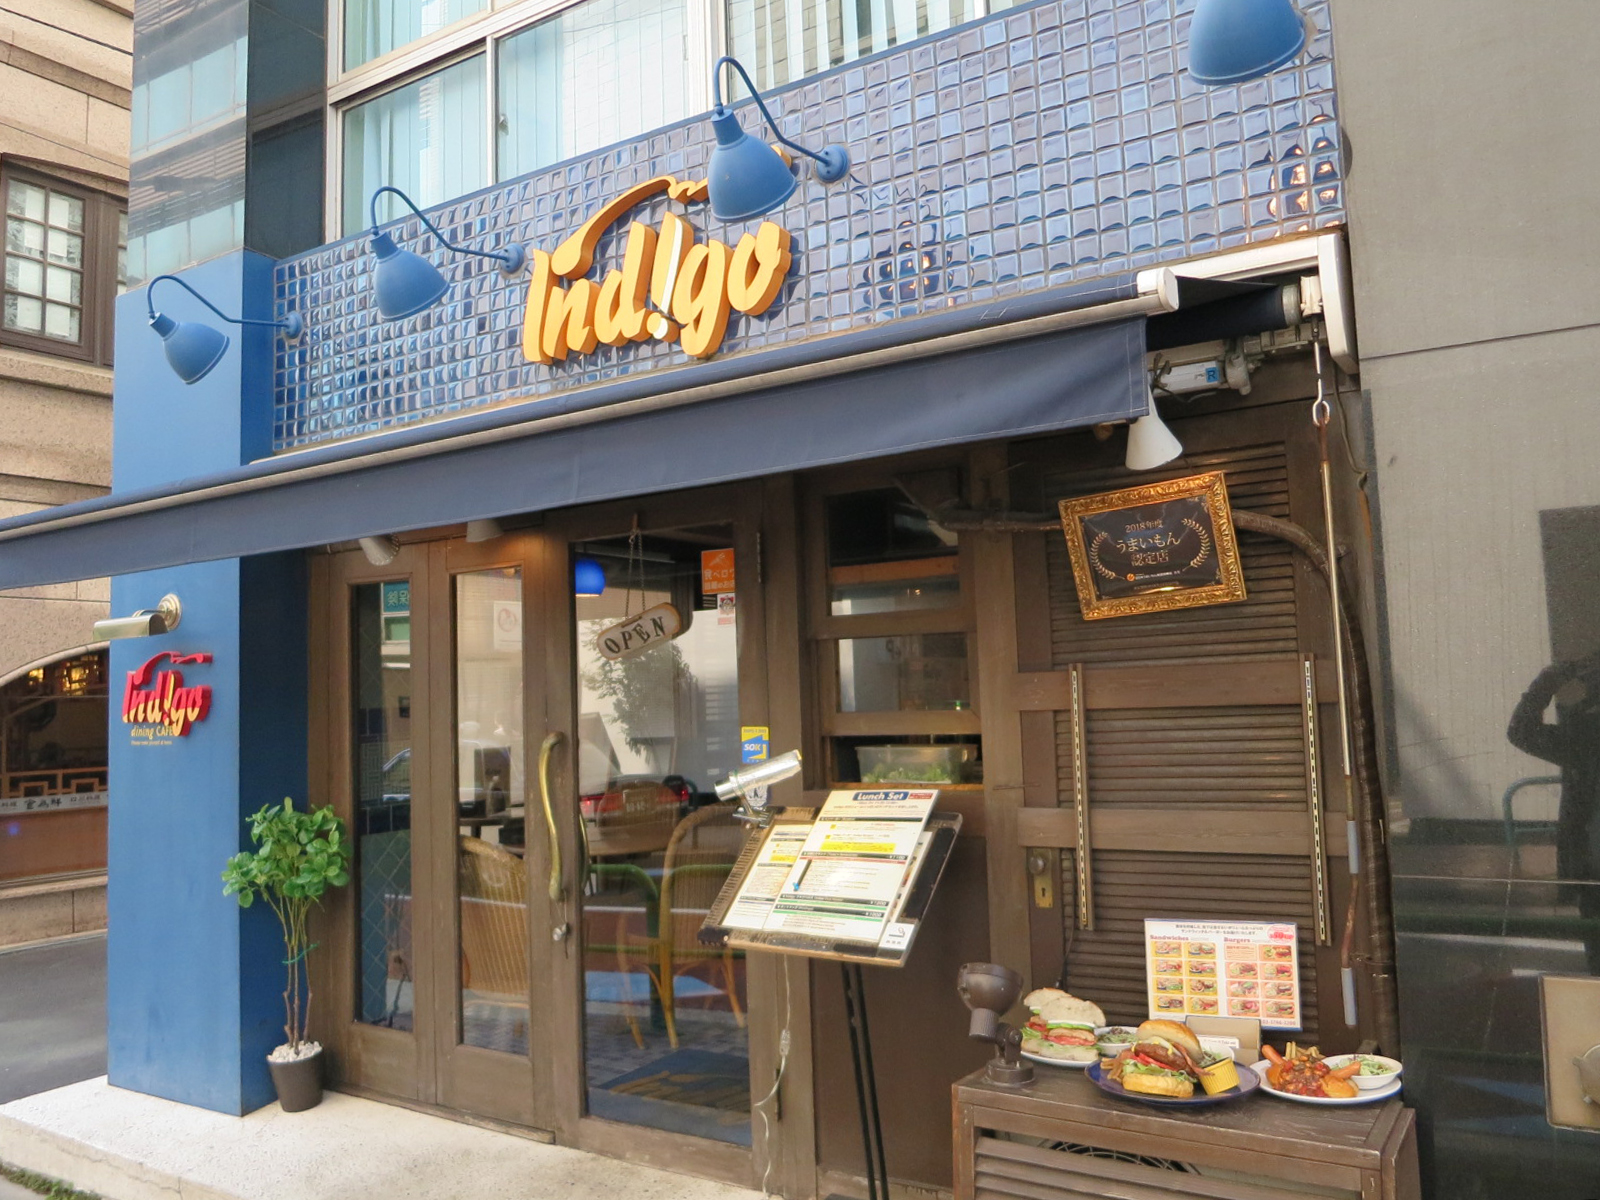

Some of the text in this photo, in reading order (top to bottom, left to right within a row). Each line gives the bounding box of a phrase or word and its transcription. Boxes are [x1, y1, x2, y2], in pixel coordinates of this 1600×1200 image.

[1207, 369, 1216, 381] R
[1125, 520, 1164, 533] 2018年度
[1116, 532, 1181, 554] うまいもん
[1131, 550, 1169, 567] 認定店
[604, 616, 666, 655] OPEN
[131, 725, 154, 740] dining
[857, 791, 886, 800] Lunch
[887, 790, 904, 800] Set
[1150, 934, 1189, 942] Sandwiches
